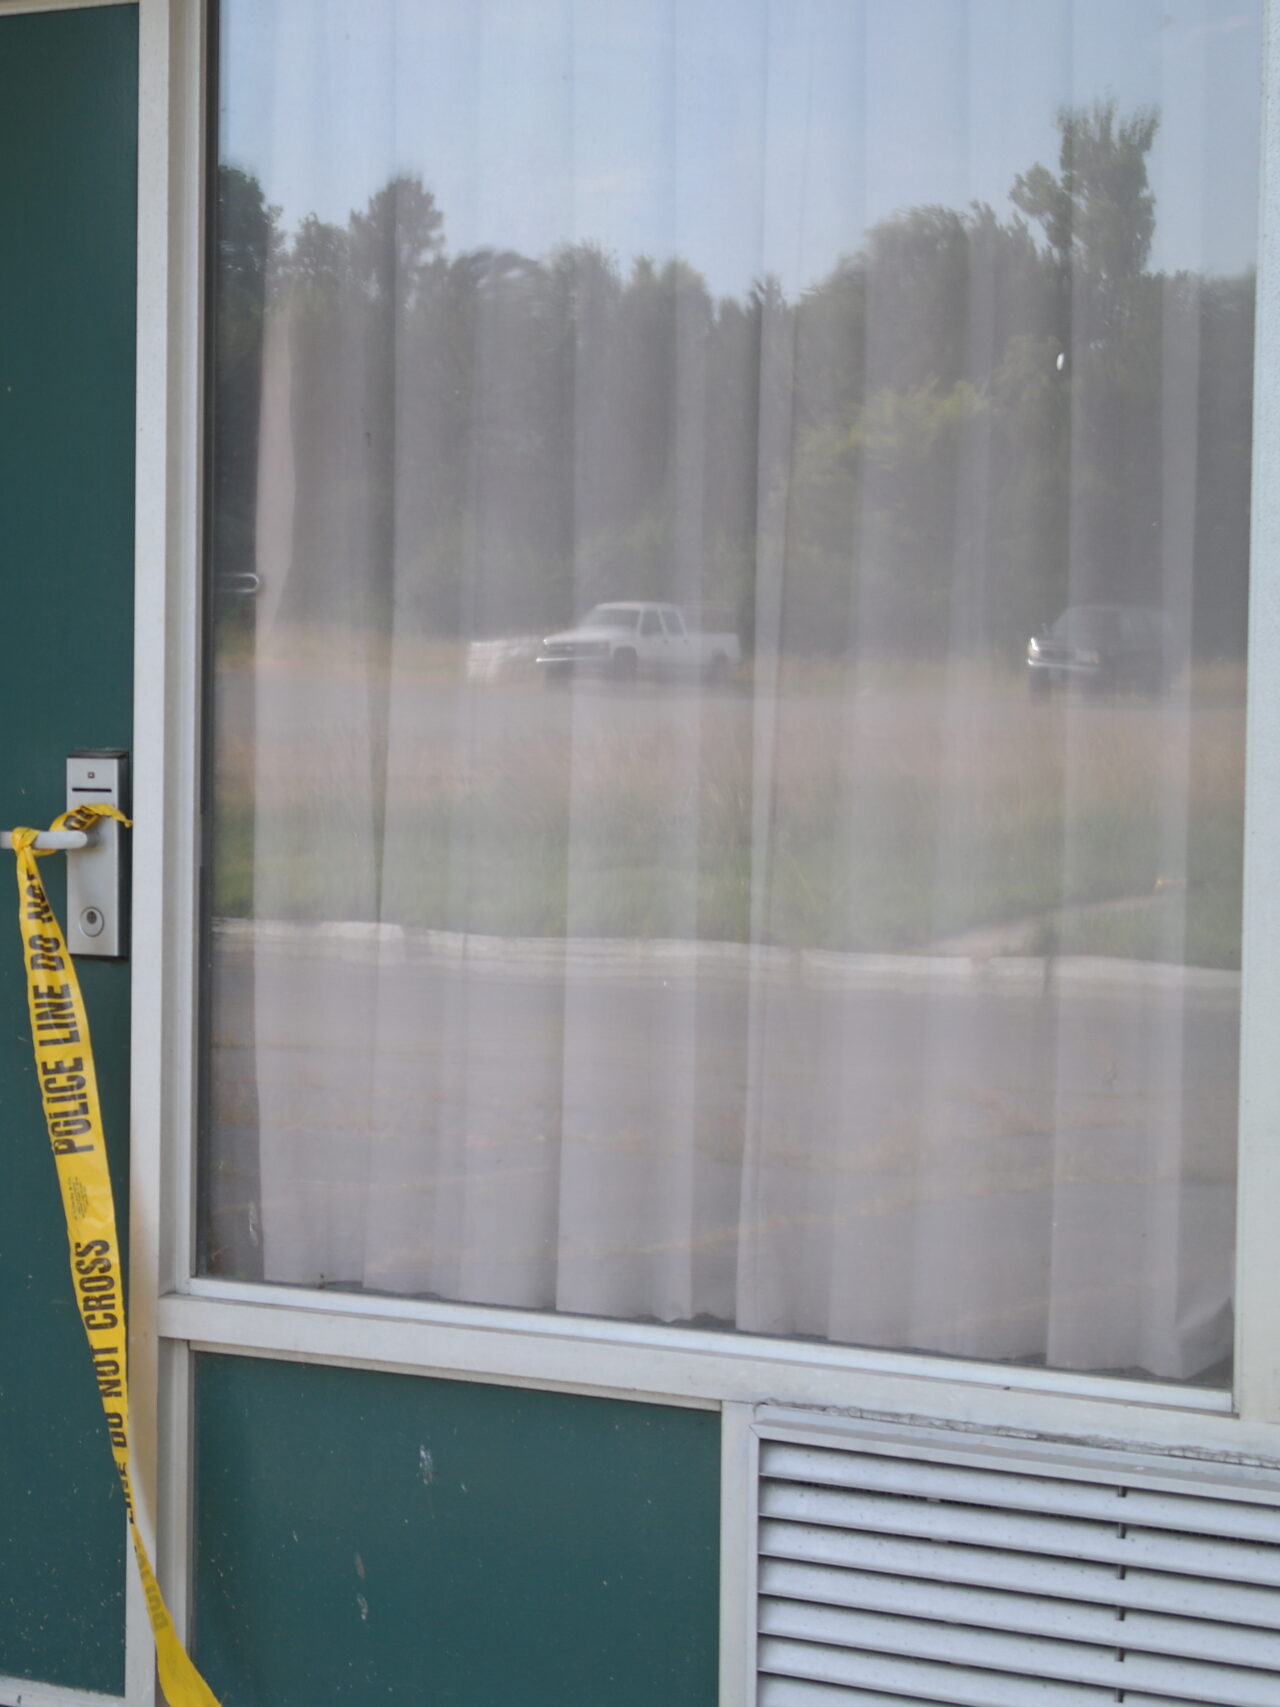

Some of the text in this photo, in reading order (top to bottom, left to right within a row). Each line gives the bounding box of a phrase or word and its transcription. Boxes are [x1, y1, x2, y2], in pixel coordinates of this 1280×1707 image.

[28, 934, 65, 971] DO
[32, 984, 80, 1047] LINE
[41, 1057, 94, 1156] POLICE
[74, 1240, 118, 1330] CROSS
[90, 1345, 122, 1398] NOT
[105, 1412, 127, 1448] DO
